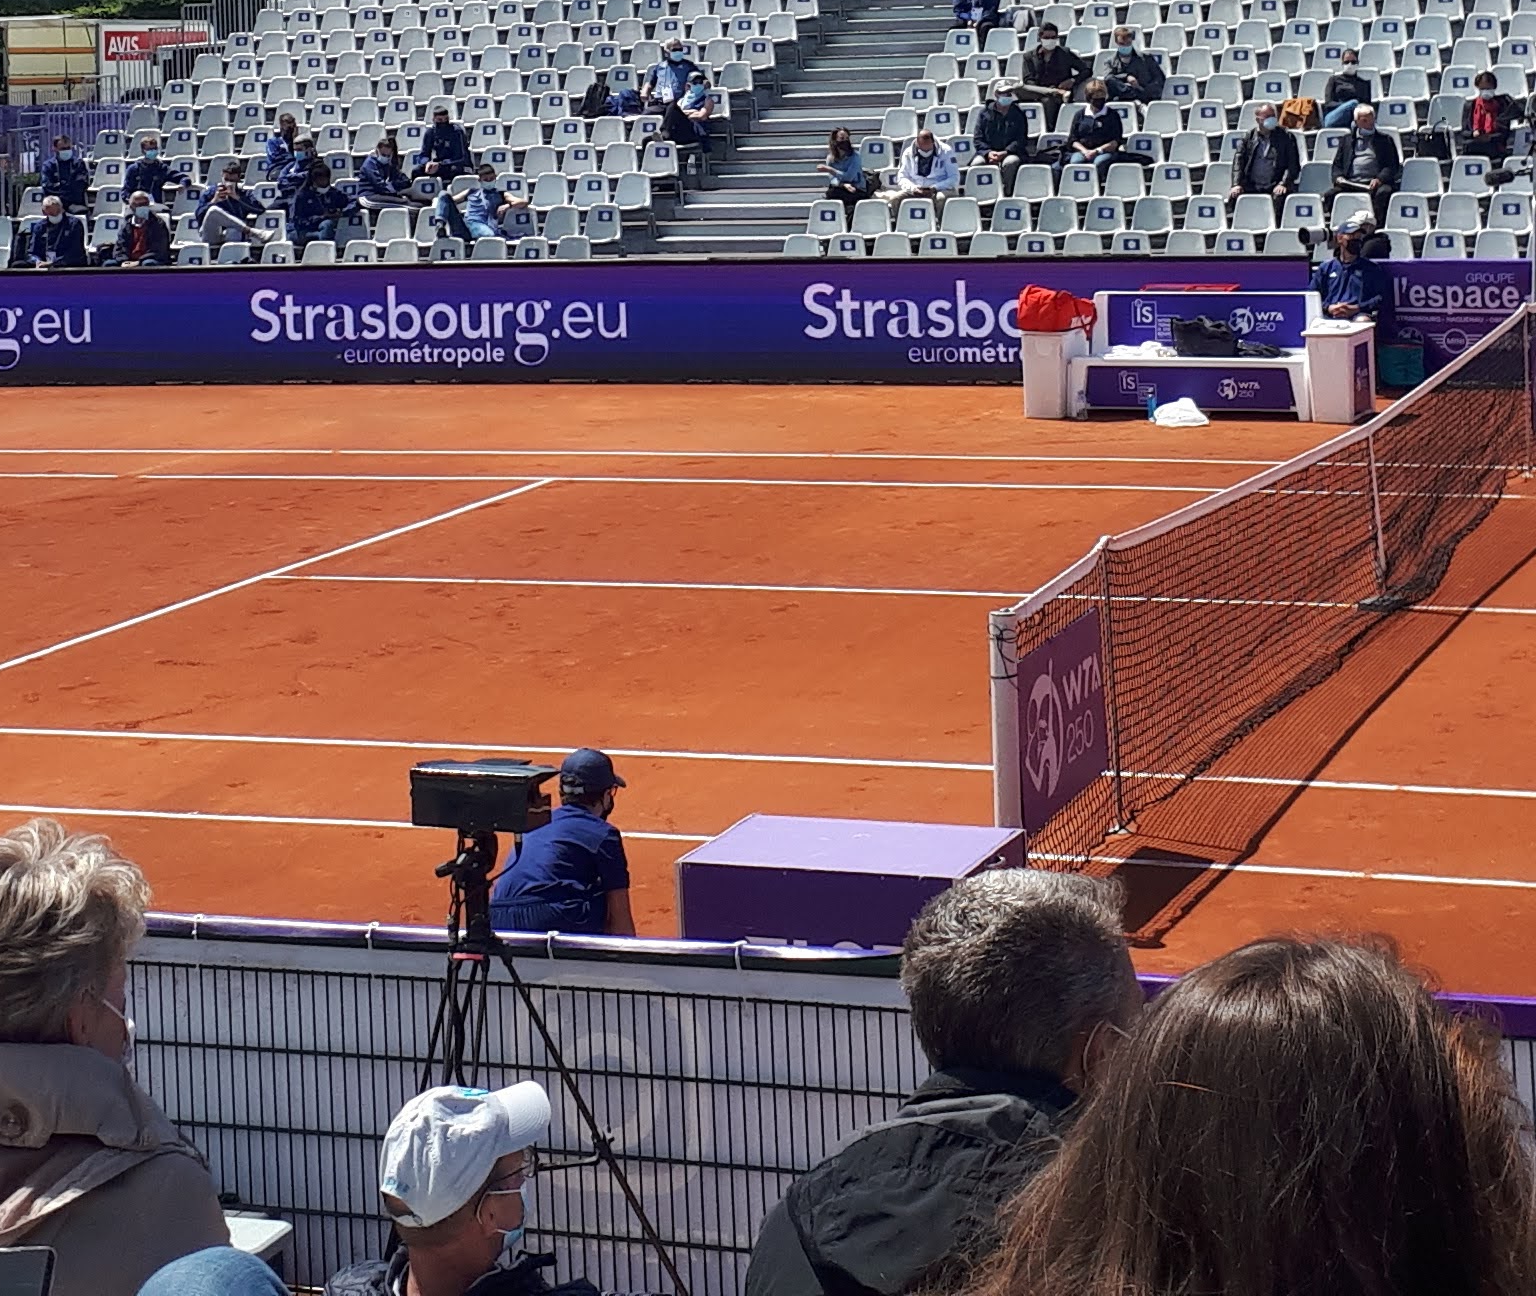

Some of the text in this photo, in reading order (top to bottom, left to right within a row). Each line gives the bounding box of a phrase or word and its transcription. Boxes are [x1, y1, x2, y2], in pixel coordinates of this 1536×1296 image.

[107, 35, 139, 56] AVIS
[1465, 272, 1515, 284] GROUPE
[1393, 277, 1521, 316] l'espace
[250, 285, 628, 366] Strasbourg.eu
[1255, 311, 1285, 322] WTA
[1255, 321, 1276, 332] 250
[343, 341, 505, 368] eurométropole
[1062, 652, 1102, 712] WTA
[1065, 708, 1095, 765] 250
